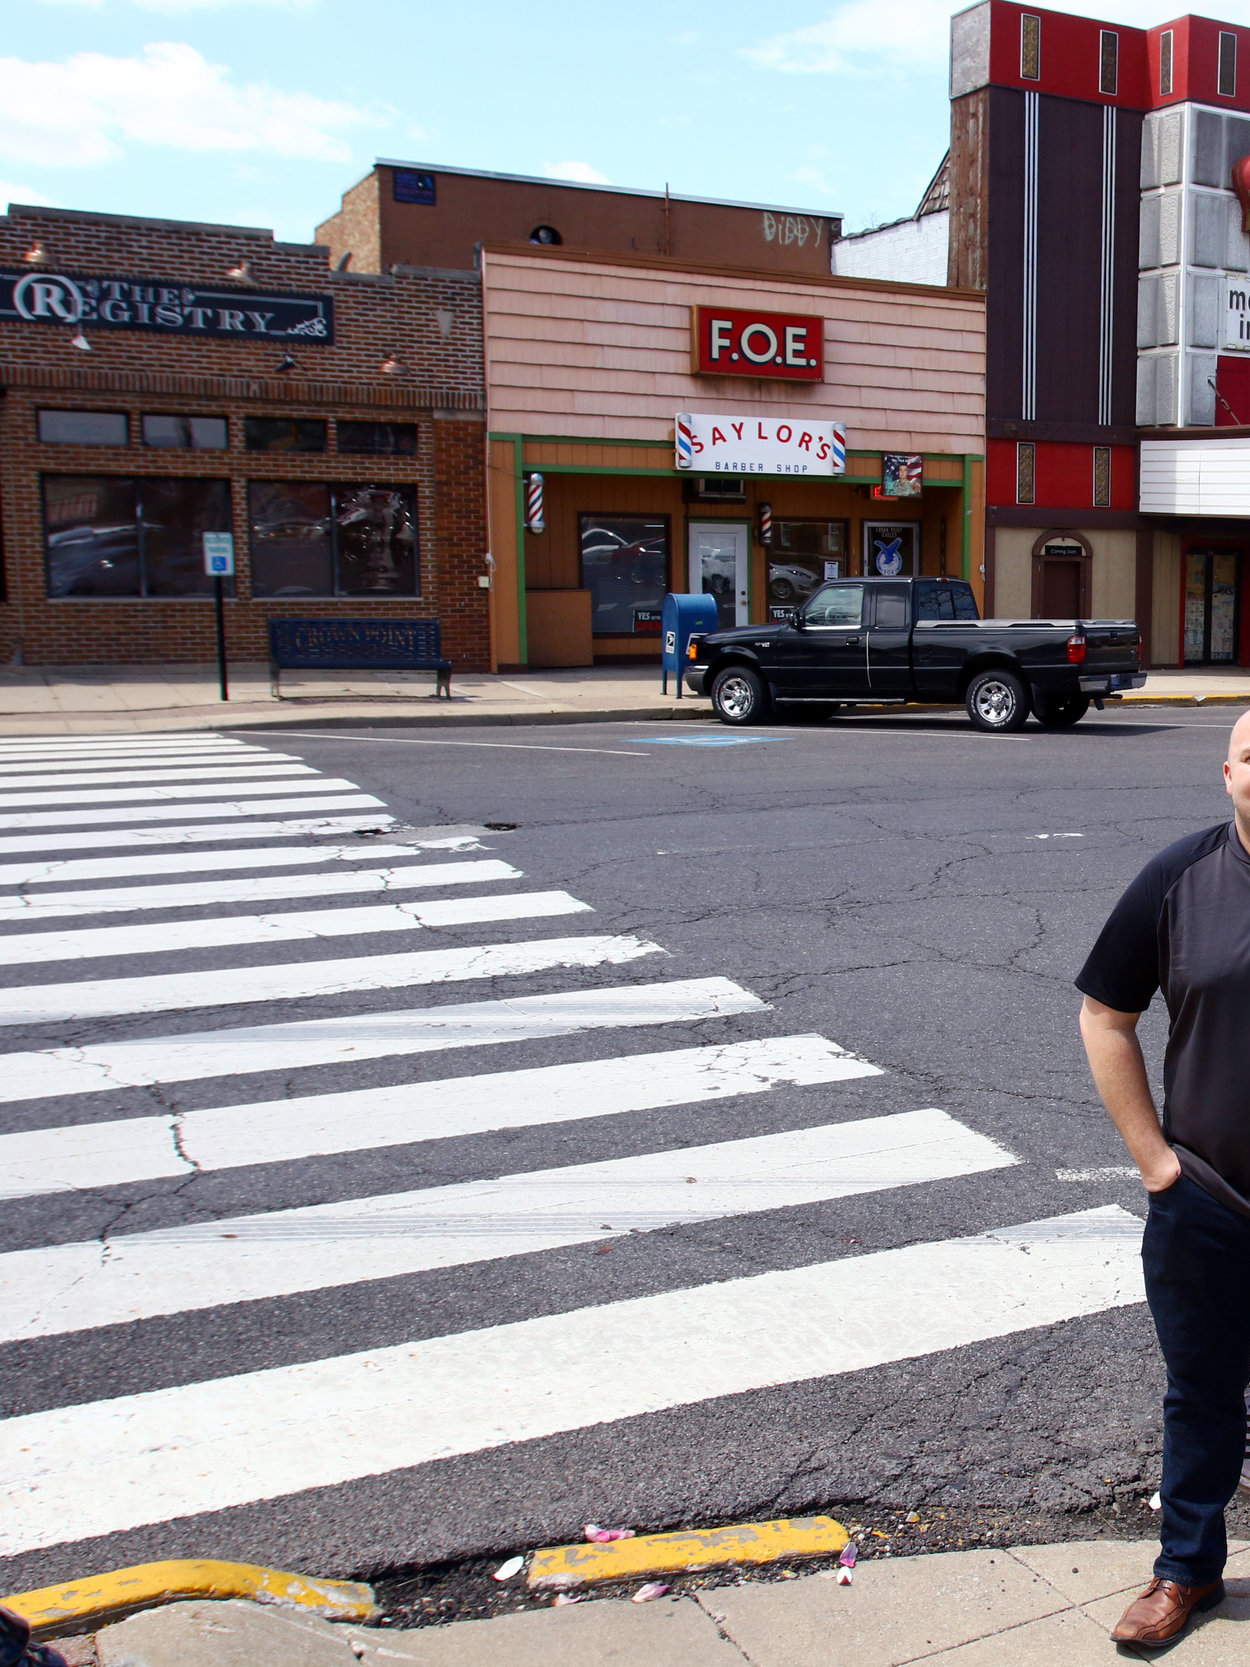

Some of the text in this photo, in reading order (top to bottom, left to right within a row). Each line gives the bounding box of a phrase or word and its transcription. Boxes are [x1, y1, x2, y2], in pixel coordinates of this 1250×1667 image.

[102, 280, 182, 304] THE
[28, 280, 275, 333] REGISTRY
[710, 319, 817, 367] F.O.E.
[690, 421, 831, 460] SAYLOR'S
[715, 461, 808, 473] BARBER SHOP
[637, 611, 650, 620] YES
[773, 609, 785, 618] YES
